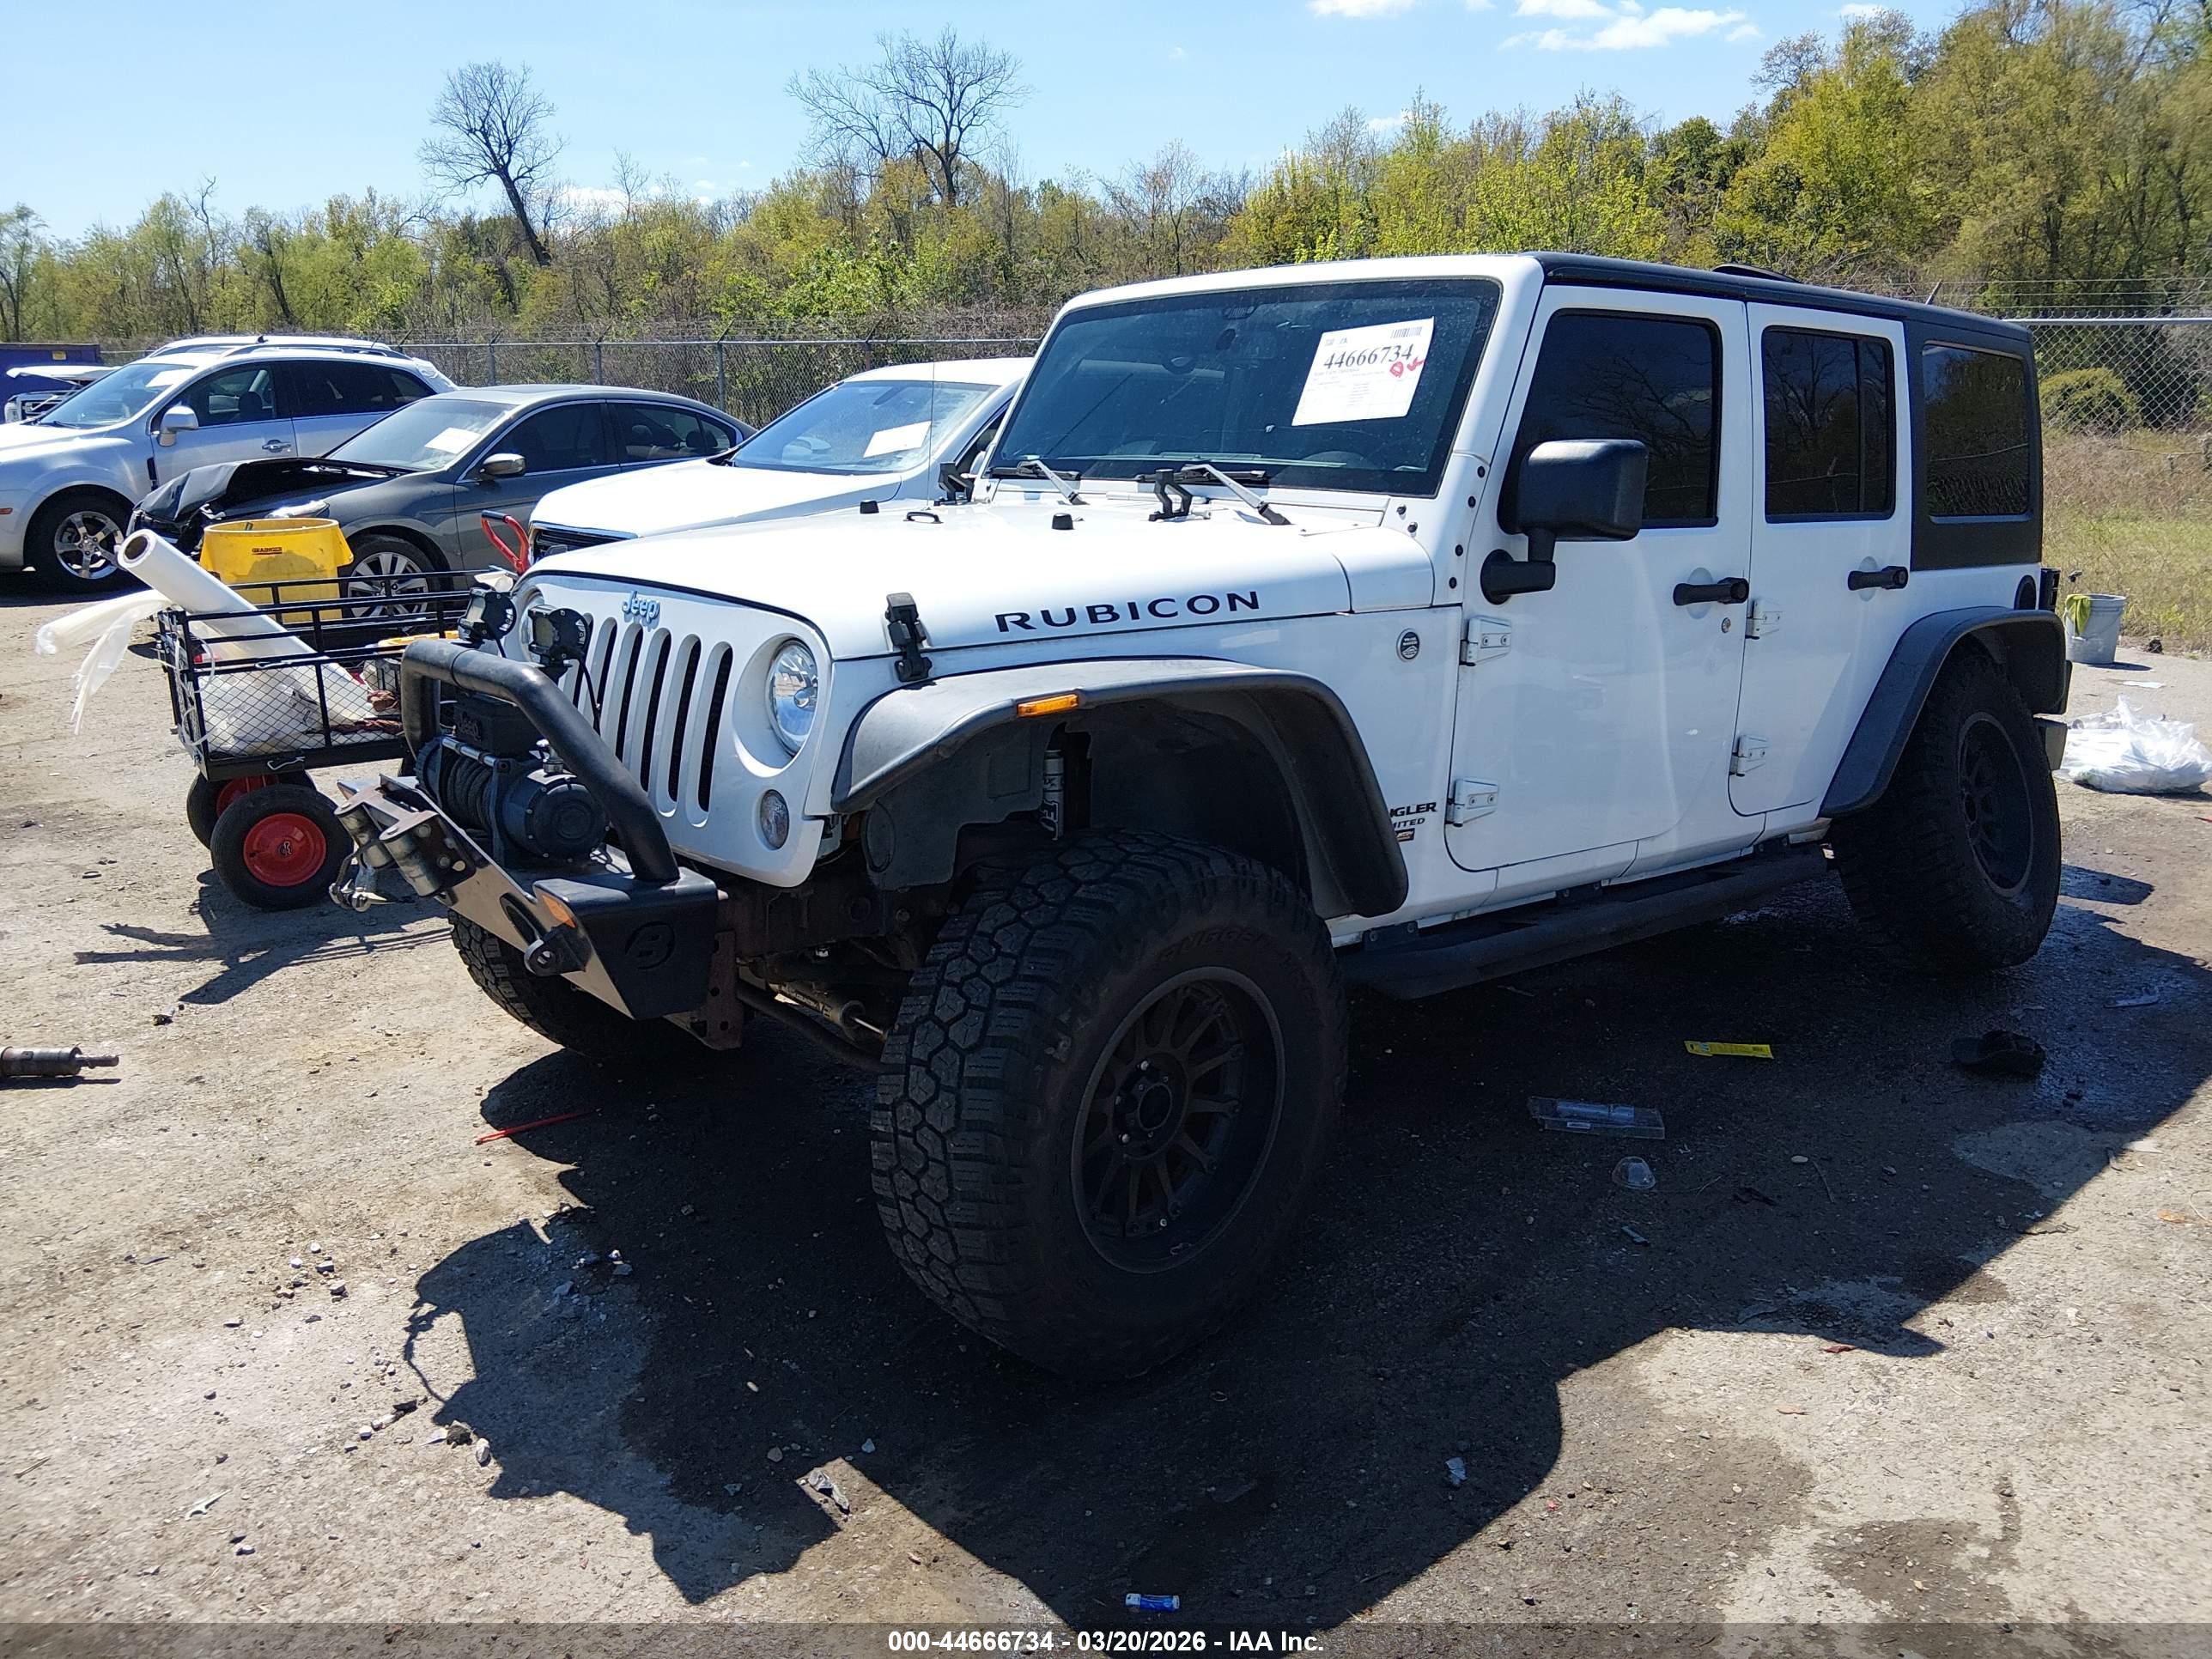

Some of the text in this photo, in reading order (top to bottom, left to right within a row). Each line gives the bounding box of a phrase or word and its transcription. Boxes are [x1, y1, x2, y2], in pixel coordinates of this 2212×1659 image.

[1323, 343, 1414, 369] 44666734
[622, 591, 660, 623] Jeep
[995, 591, 1260, 633] RUBICON
